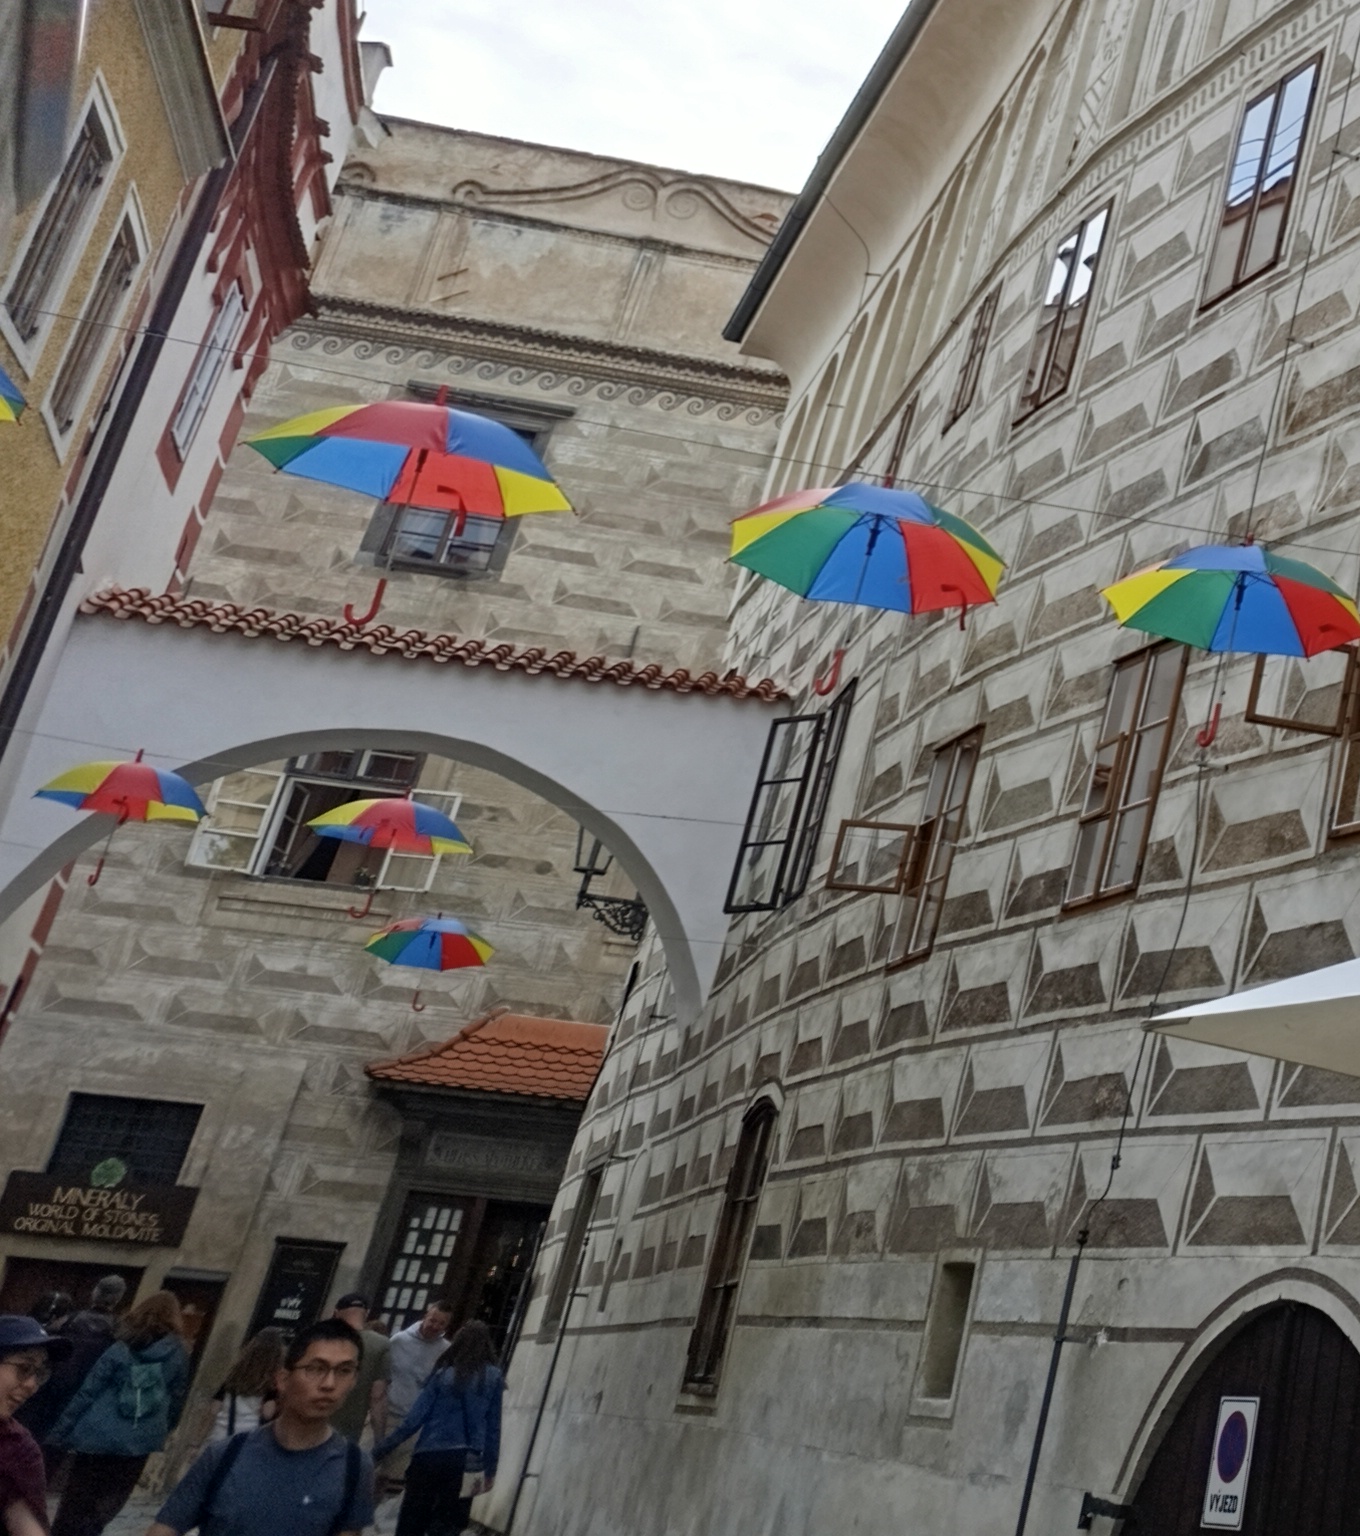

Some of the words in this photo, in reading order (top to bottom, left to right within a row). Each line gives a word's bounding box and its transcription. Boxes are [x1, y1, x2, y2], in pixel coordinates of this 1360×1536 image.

[52, 1185, 146, 1211] MINERÁLY
[28, 1202, 79, 1220] WORLD
[82, 1208, 101, 1222] OF
[104, 1210, 160, 1228] STONES
[13, 1216, 77, 1236] ORIGINAL
[82, 1223, 163, 1242] MOLDAVITE
[1209, 1489, 1239, 1513] VÝJEZD
